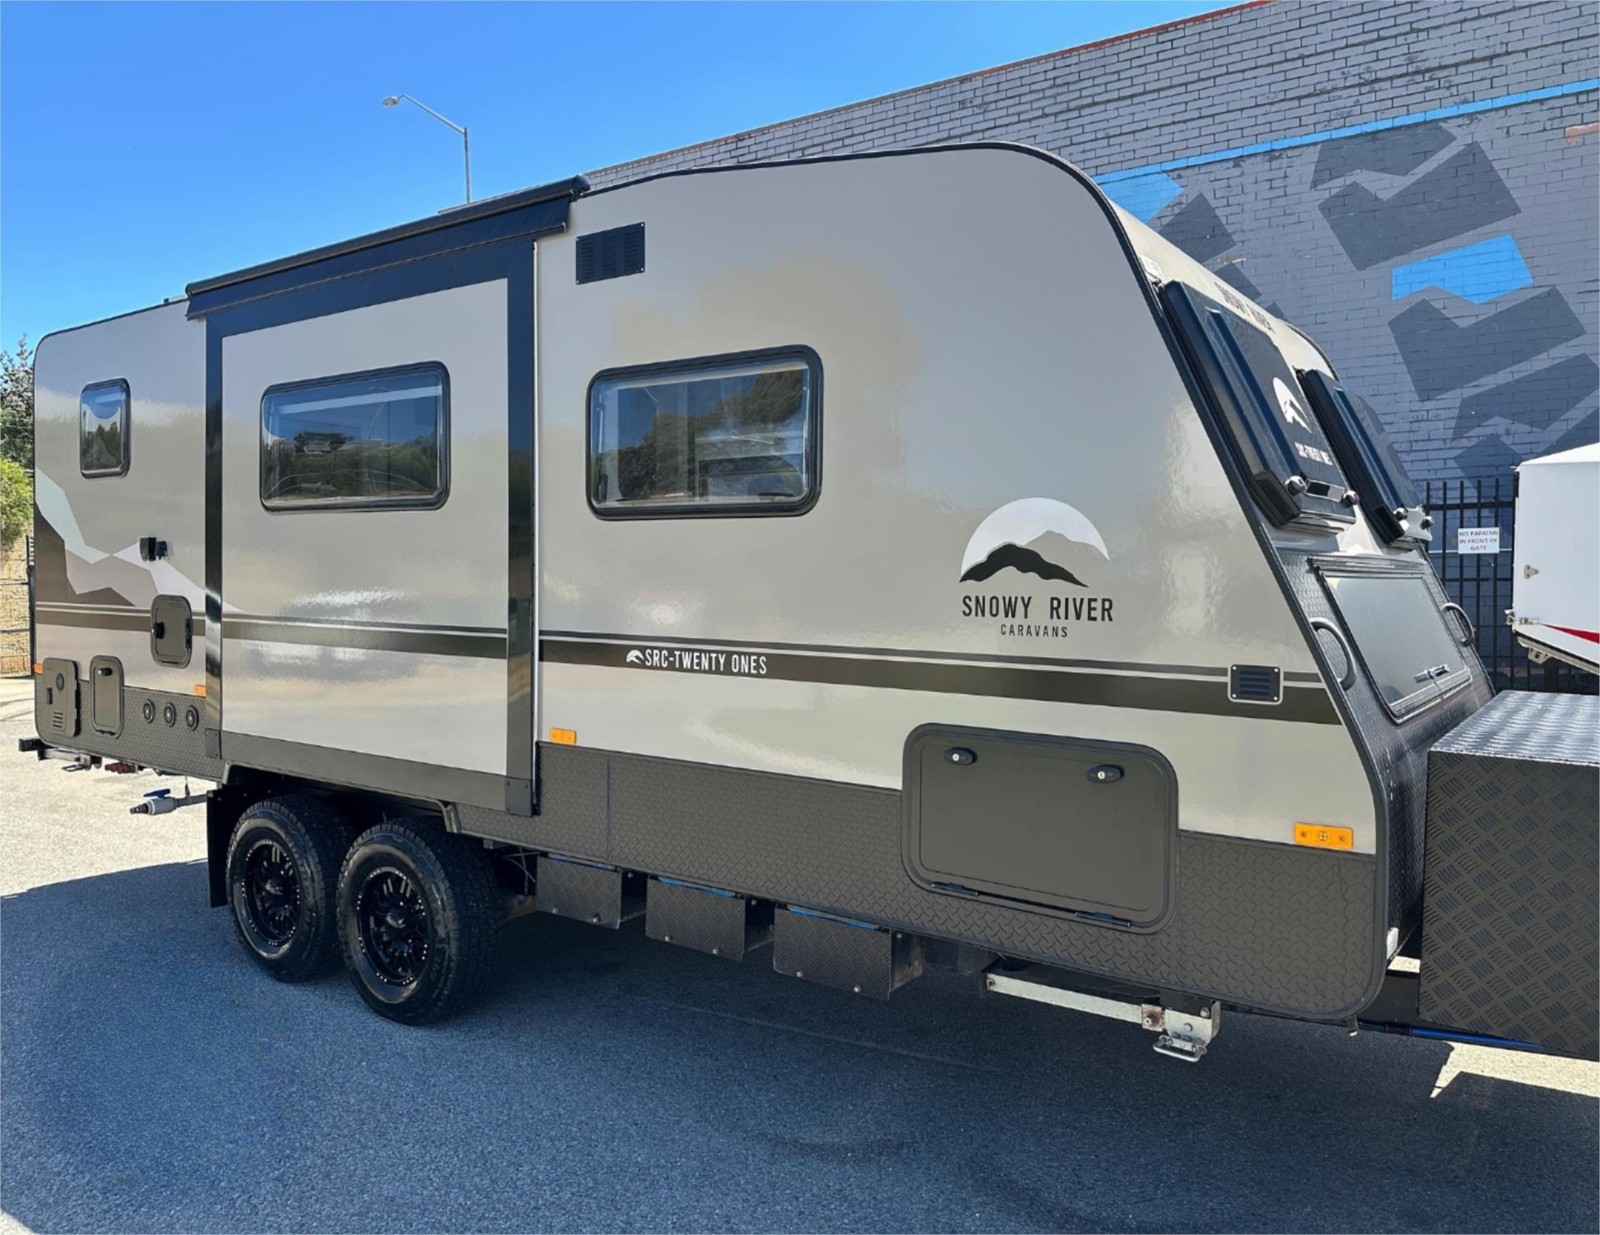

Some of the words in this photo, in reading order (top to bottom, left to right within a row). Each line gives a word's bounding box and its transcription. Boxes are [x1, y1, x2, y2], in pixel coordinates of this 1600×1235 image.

[962, 595, 1033, 619] SNOWY
[1050, 597, 1113, 622] RIVER
[1000, 624, 1068, 638] CARAVANS
[645, 649, 726, 672] SRC-TWENTY
[731, 654, 767, 674] ONES
